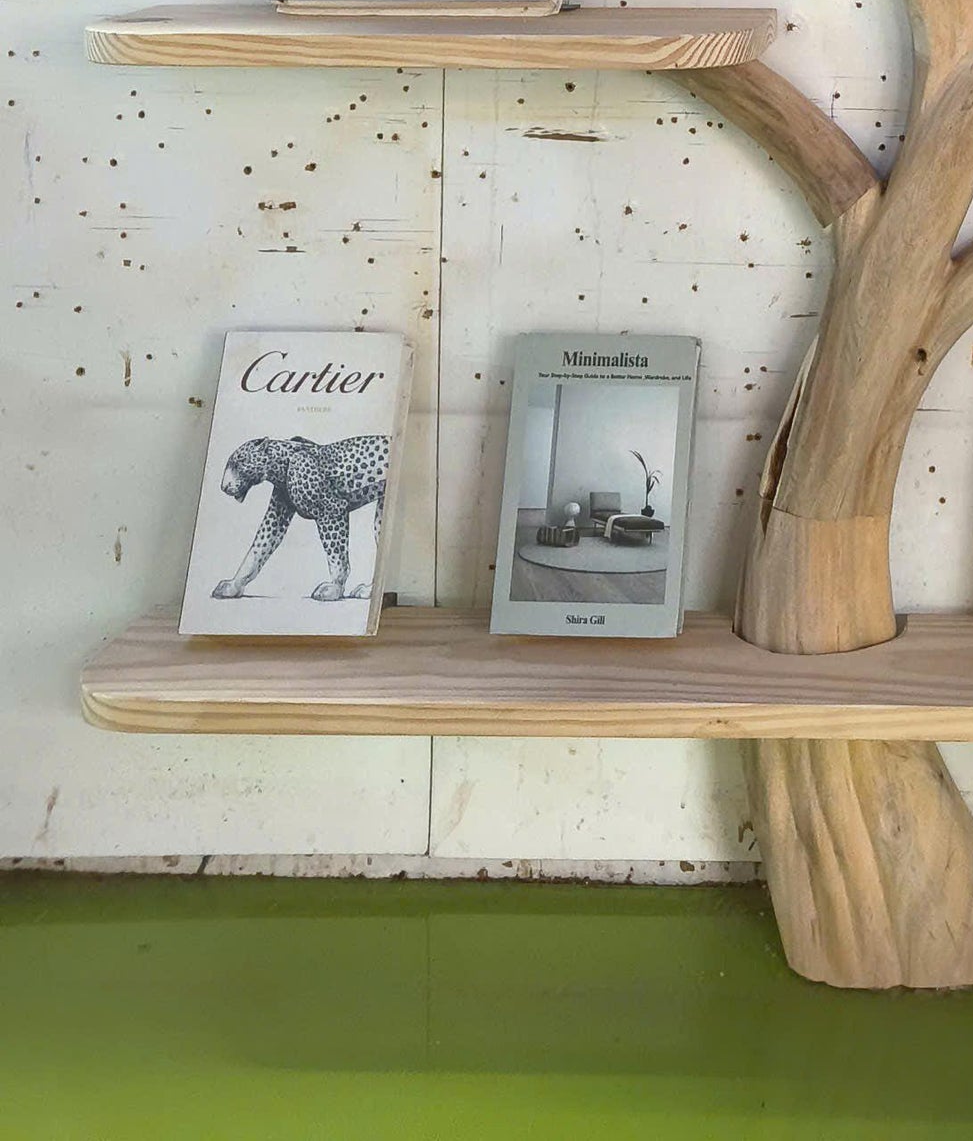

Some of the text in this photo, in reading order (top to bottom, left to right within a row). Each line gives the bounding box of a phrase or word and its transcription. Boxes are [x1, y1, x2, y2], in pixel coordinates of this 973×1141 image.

[562, 351, 649, 368] Minimalista
[240, 350, 385, 393] Cartier
[566, 614, 606, 625] Shira Gill
